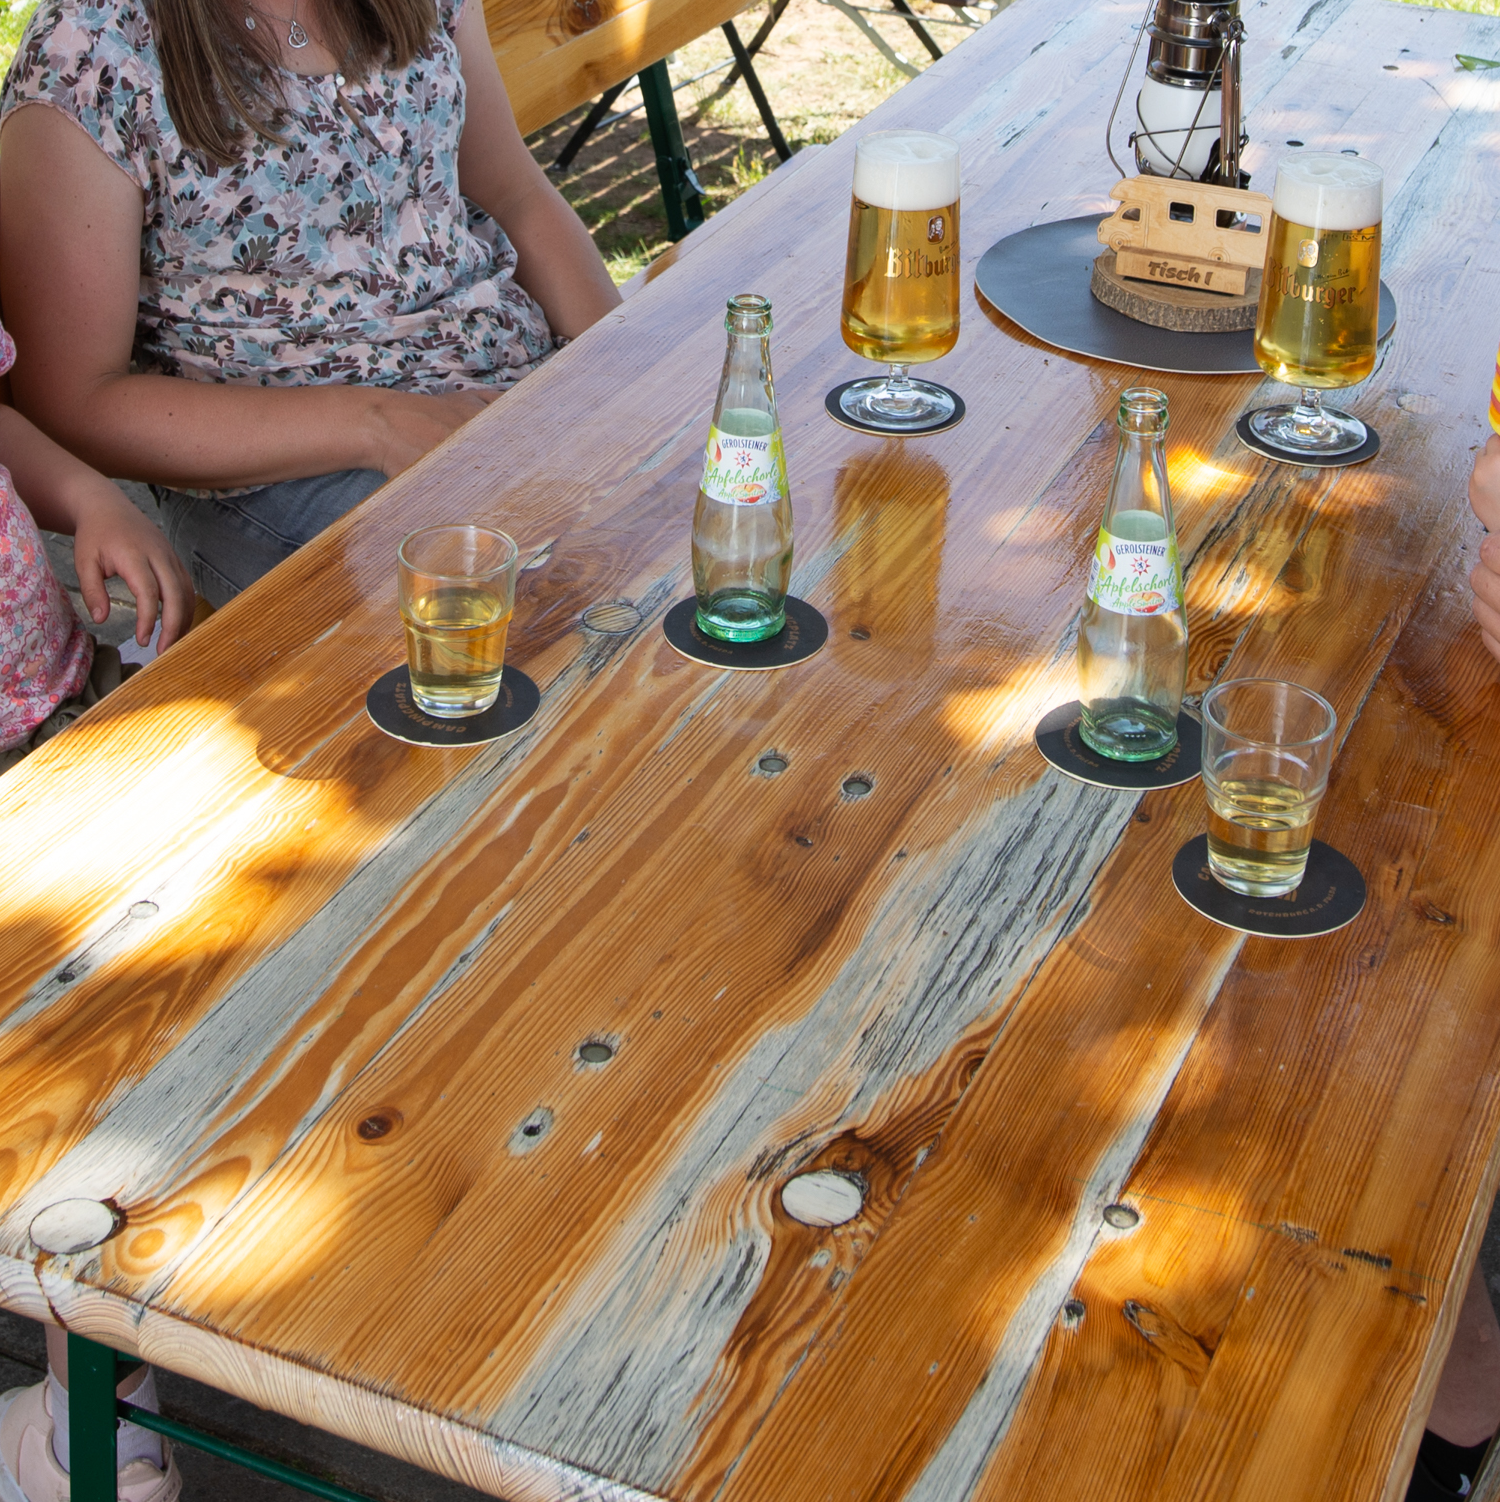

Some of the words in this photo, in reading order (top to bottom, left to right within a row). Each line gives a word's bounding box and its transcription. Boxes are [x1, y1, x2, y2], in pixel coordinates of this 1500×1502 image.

[1148, 261, 1202, 284] Tisch
[721, 438, 768, 452] GEROLSTEINER
[708, 463, 777, 488] Apfelschorle
[1115, 543, 1166, 557] GEROLSTEINER
[1100, 568, 1175, 597] Apfelschorle
